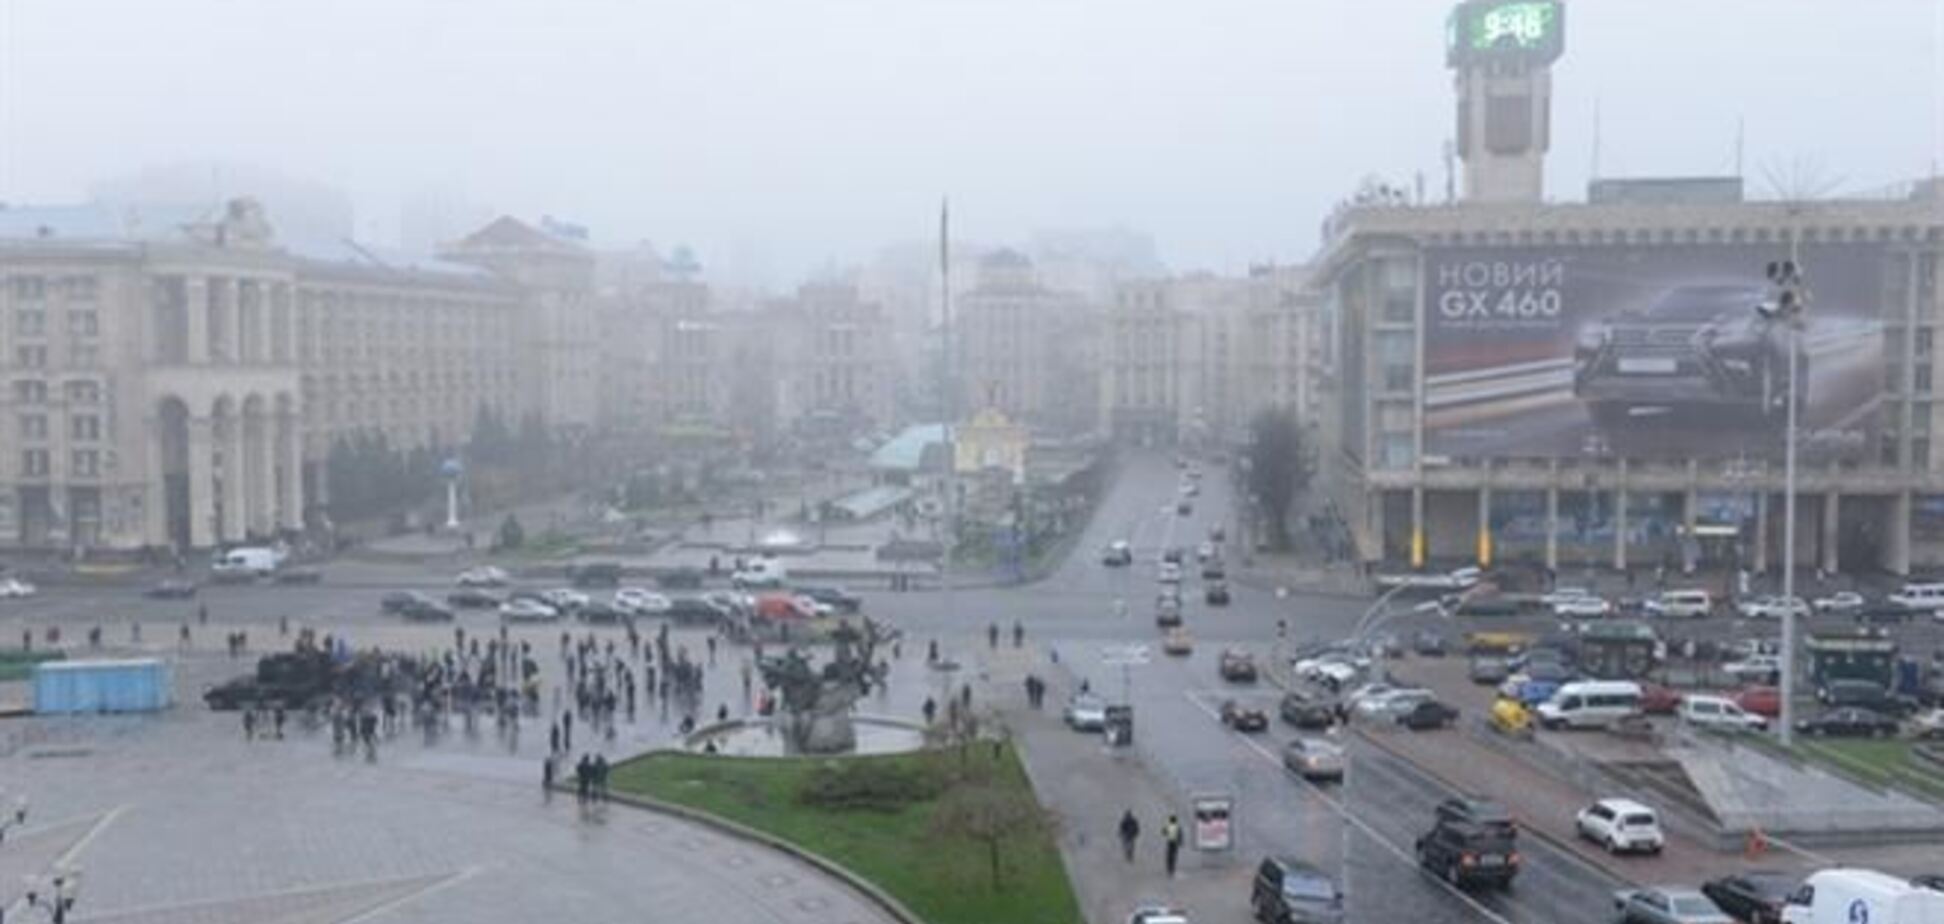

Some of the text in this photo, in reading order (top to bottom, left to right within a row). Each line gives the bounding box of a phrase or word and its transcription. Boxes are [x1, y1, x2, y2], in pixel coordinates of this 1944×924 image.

[1438, 258, 1564, 287] НОВИЙ
[1440, 288, 1561, 318] GX 460
